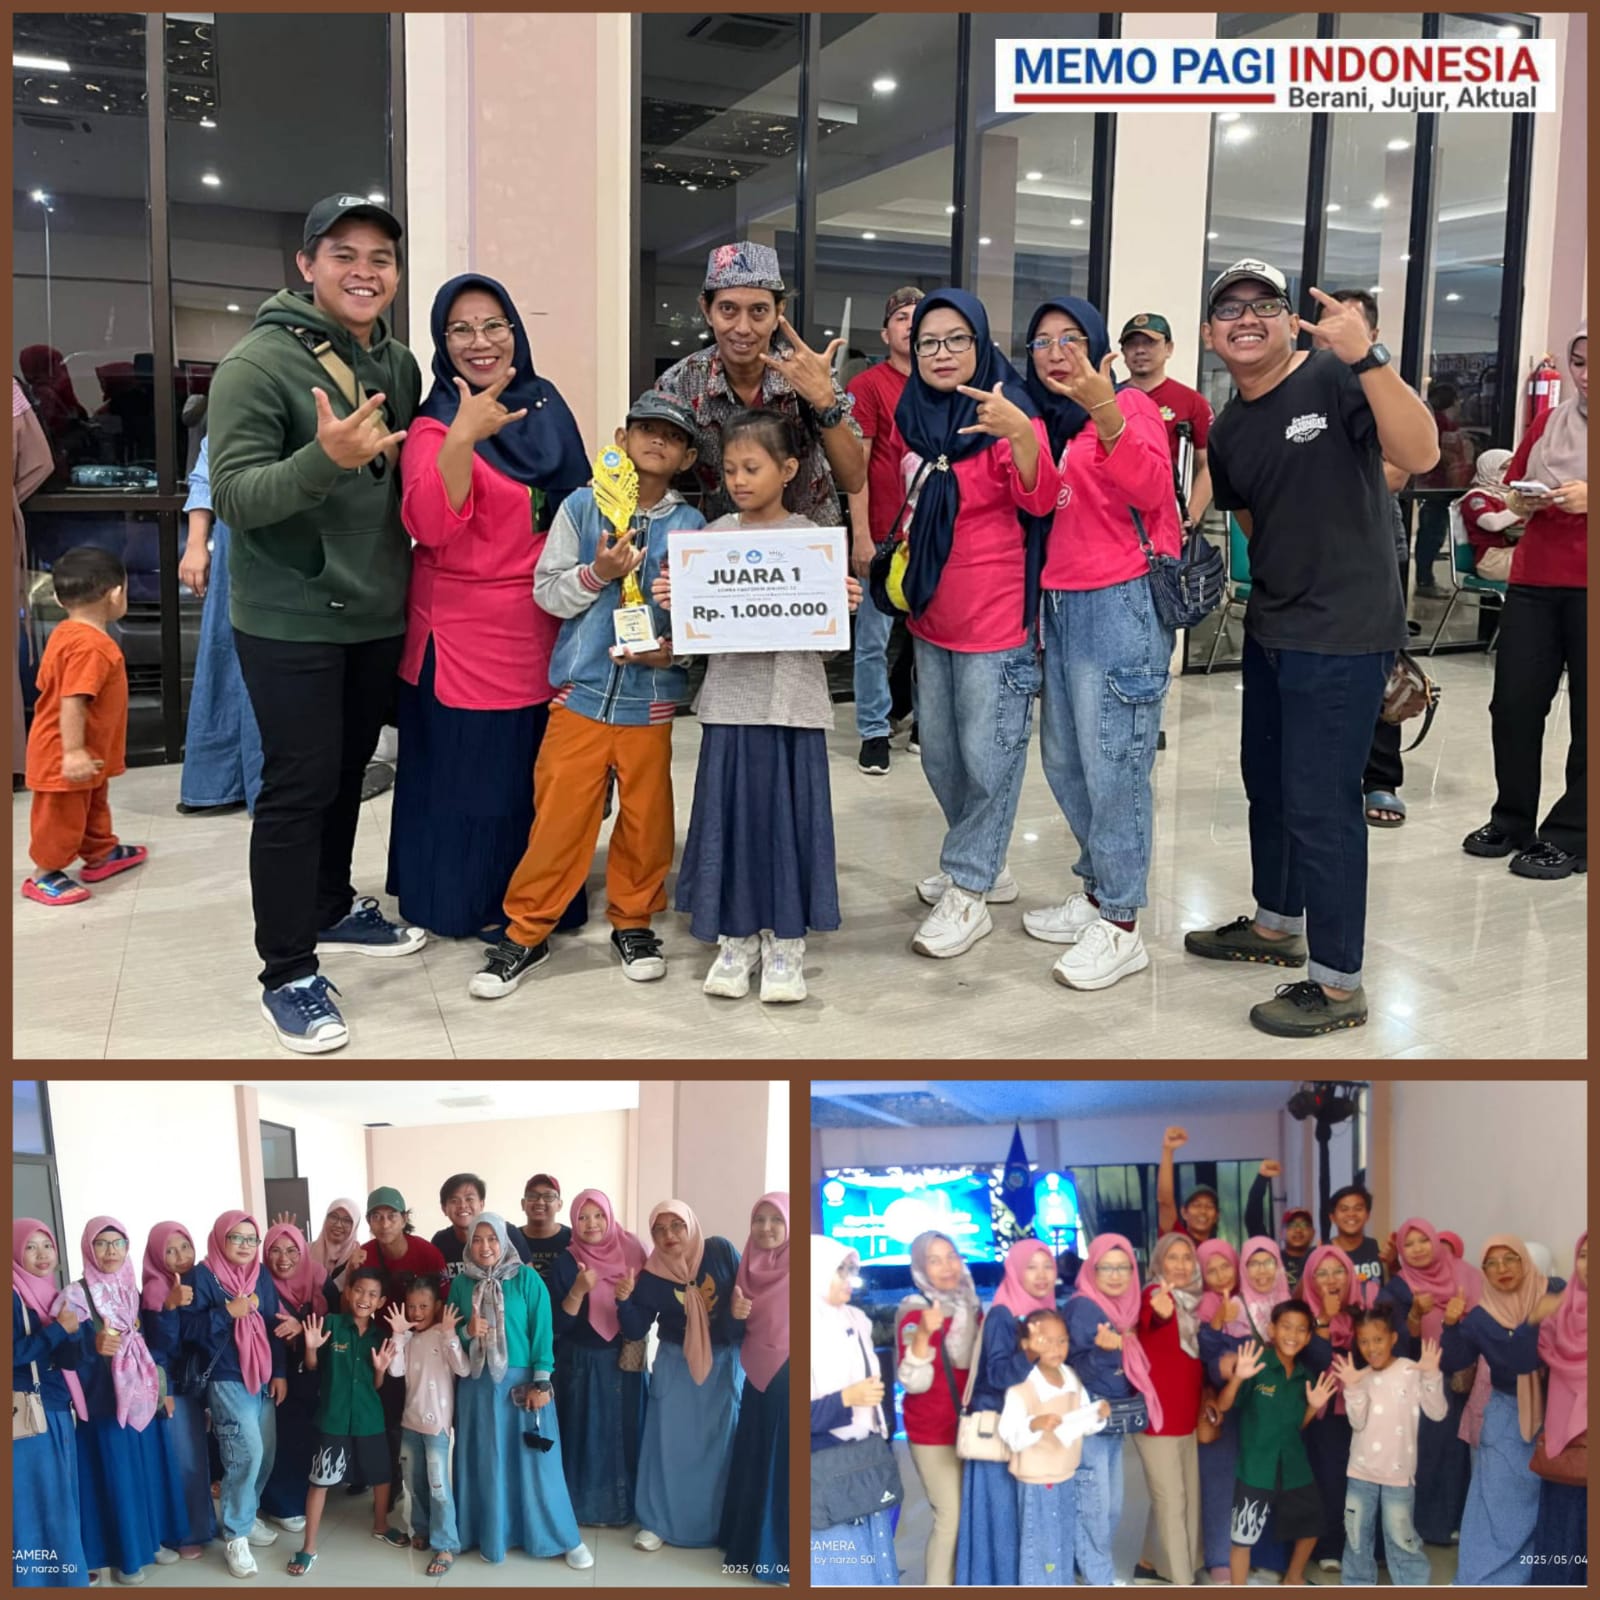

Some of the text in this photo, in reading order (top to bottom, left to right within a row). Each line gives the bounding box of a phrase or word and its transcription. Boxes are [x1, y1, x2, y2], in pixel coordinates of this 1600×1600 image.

[707, 566, 801, 585] JUARA 1
[692, 601, 828, 622] Rp. 1.000.000
